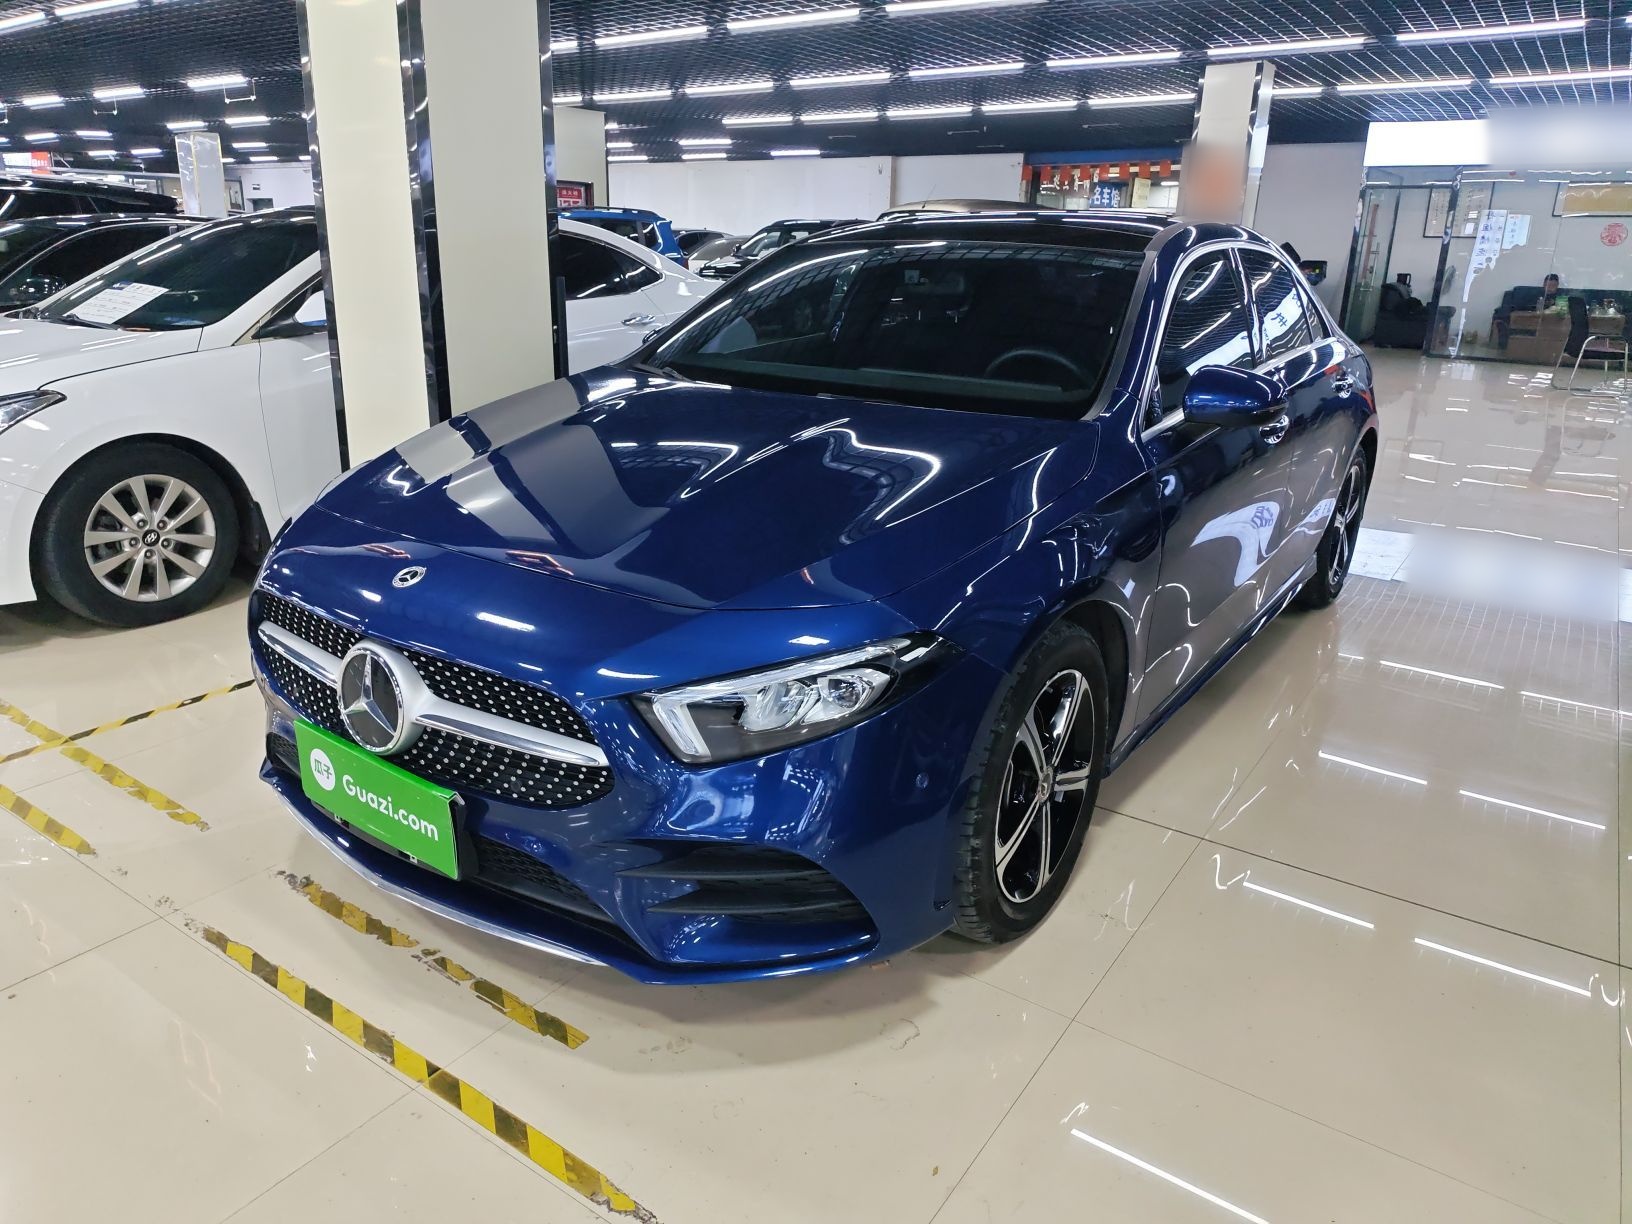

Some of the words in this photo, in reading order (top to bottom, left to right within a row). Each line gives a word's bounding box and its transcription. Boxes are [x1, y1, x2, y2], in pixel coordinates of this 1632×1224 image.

[1089, 184, 1121, 208] 名车馆
[313, 758, 333, 780] 瓜子
[342, 774, 439, 842] Guazi.com
